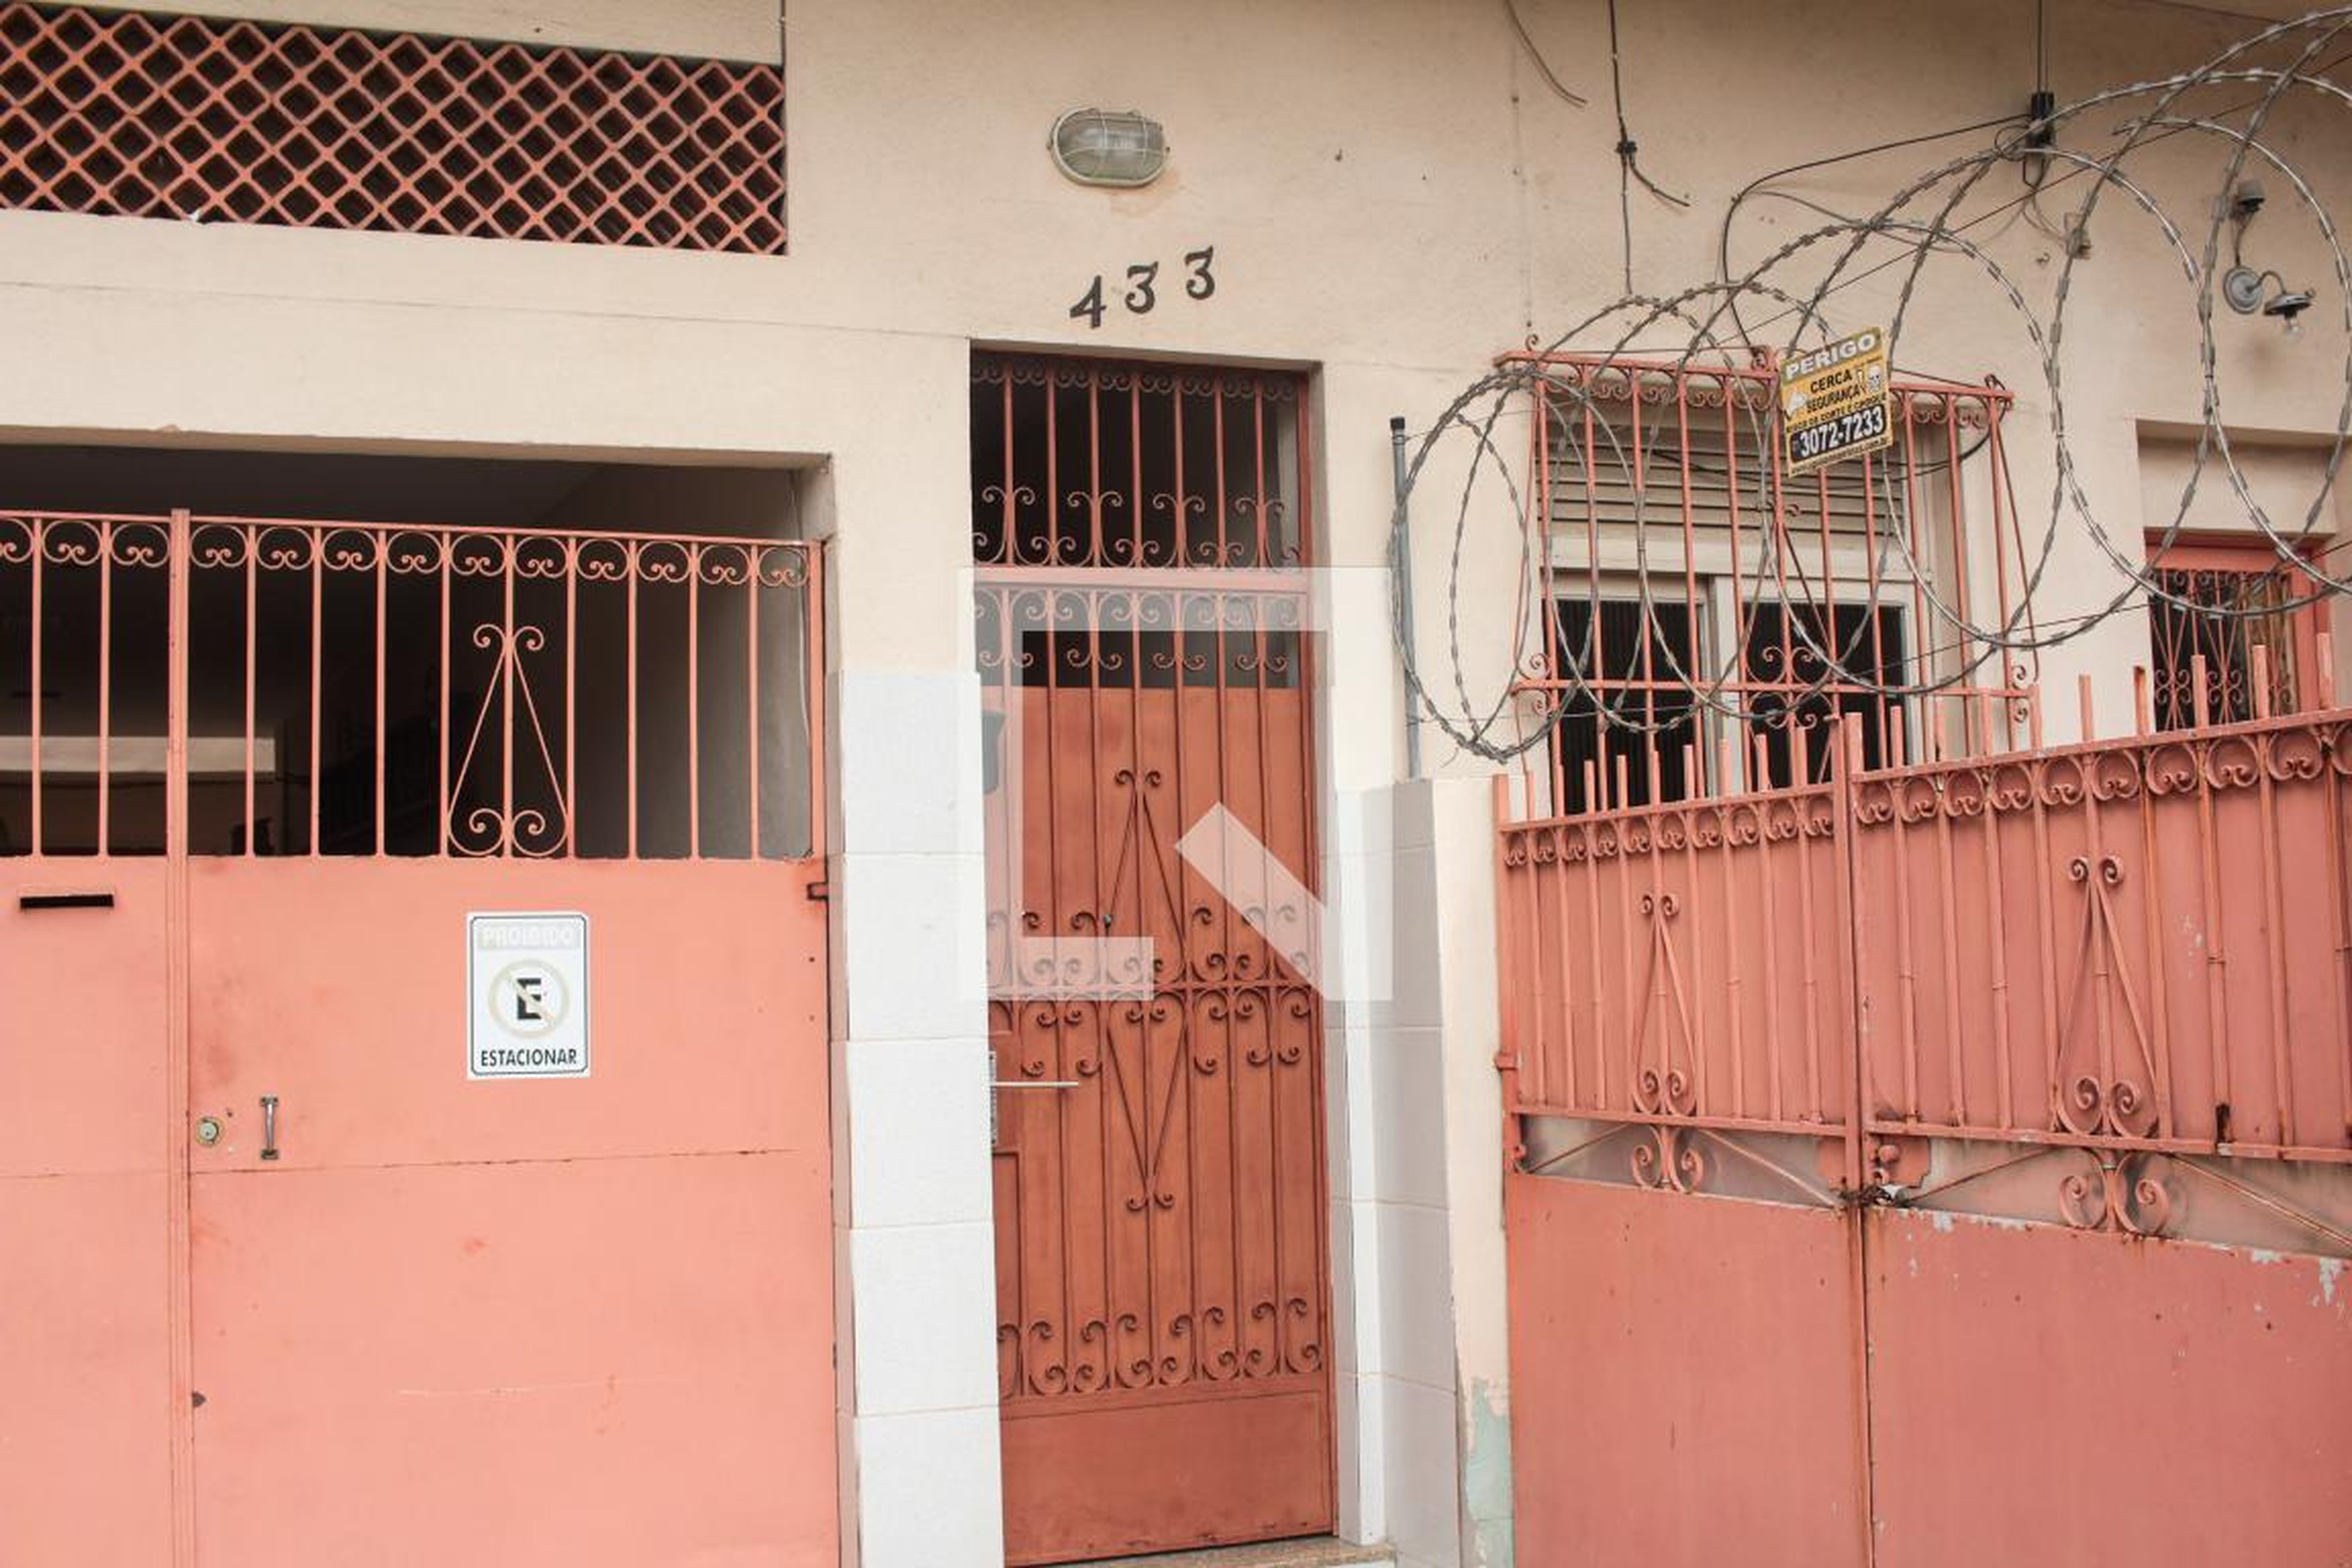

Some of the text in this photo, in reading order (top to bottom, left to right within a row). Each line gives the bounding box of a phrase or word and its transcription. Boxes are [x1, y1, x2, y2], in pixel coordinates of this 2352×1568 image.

[1069, 245, 1215, 329] 433
[1785, 334, 1875, 380] PERIGO
[1806, 385, 1860, 413] SEGURANÇA
[1810, 369, 1853, 394] CERCA
[1800, 406, 1883, 458] 3072-7233
[481, 1049, 577, 1066] ESTACIONAR
